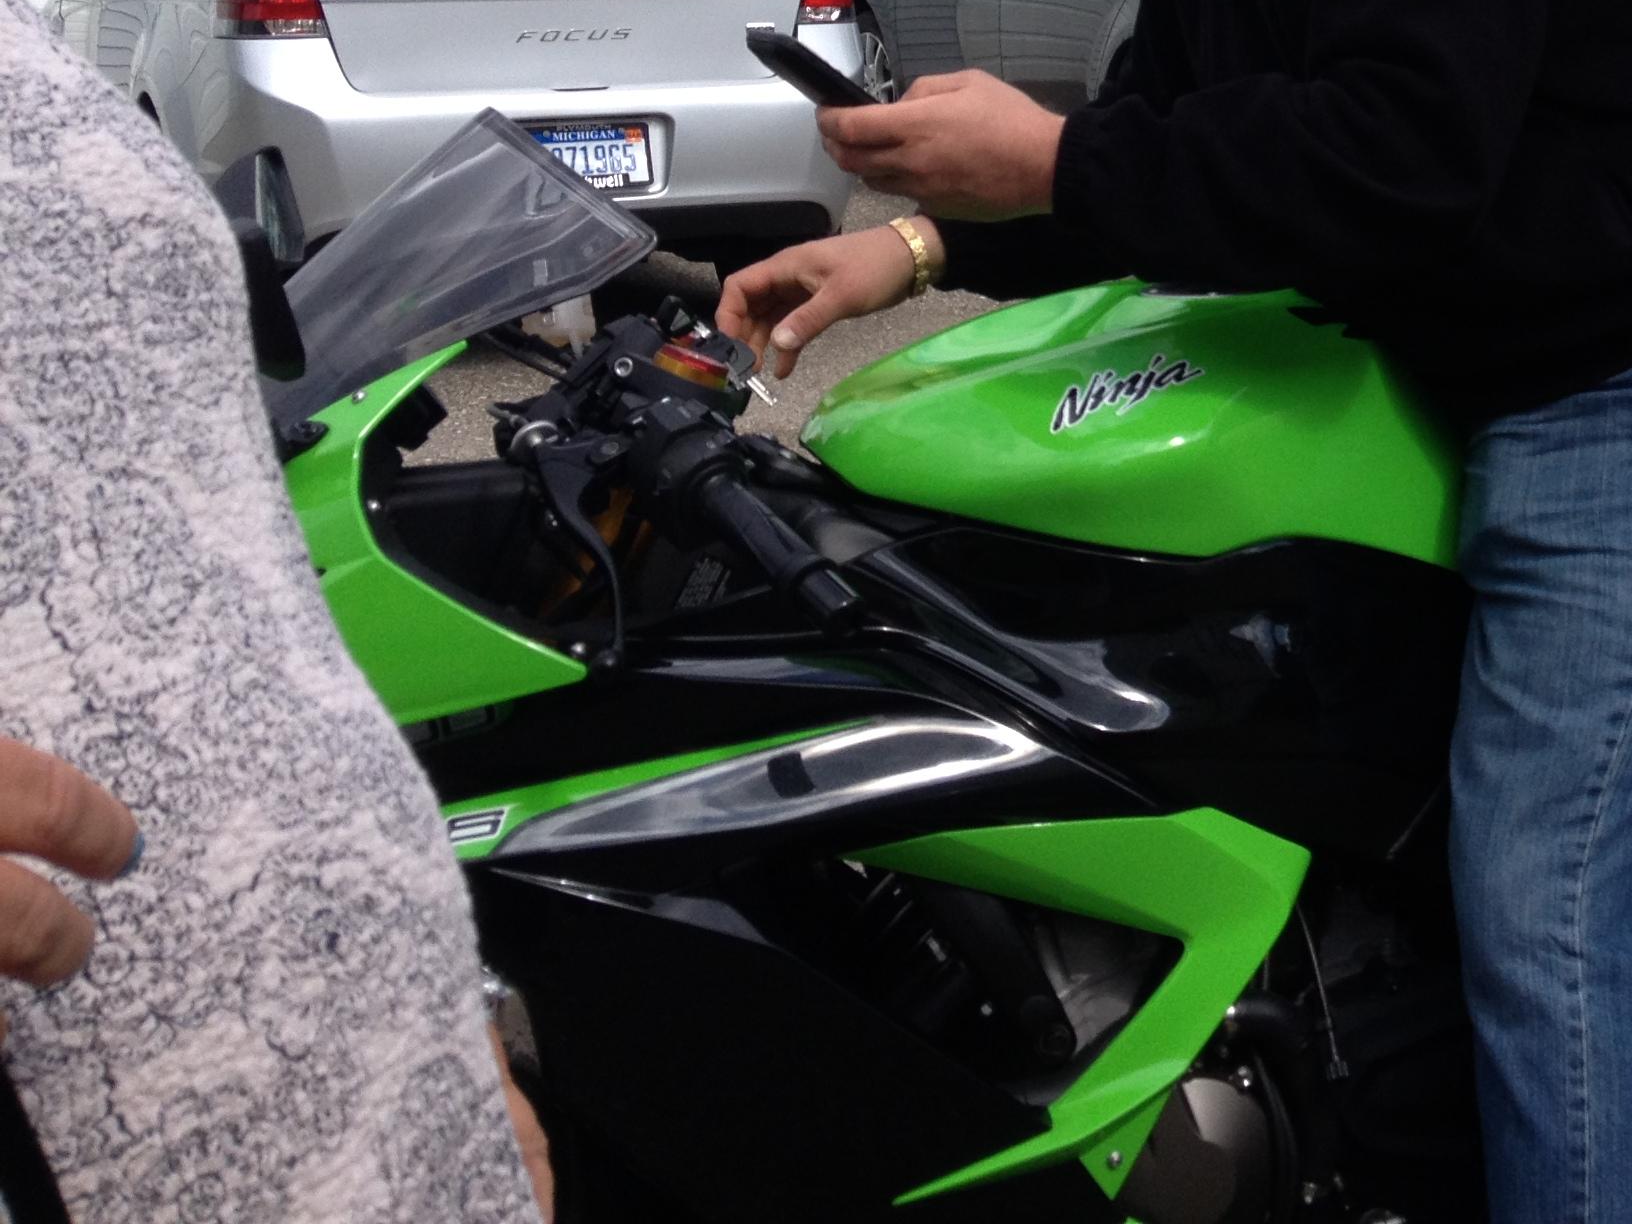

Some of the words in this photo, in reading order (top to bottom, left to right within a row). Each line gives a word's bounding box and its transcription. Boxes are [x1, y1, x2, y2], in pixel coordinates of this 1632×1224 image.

[515, 28, 633, 44] FOCUS
[552, 130, 616, 142] MICHIGAN
[1050, 353, 1205, 435] Ninja
